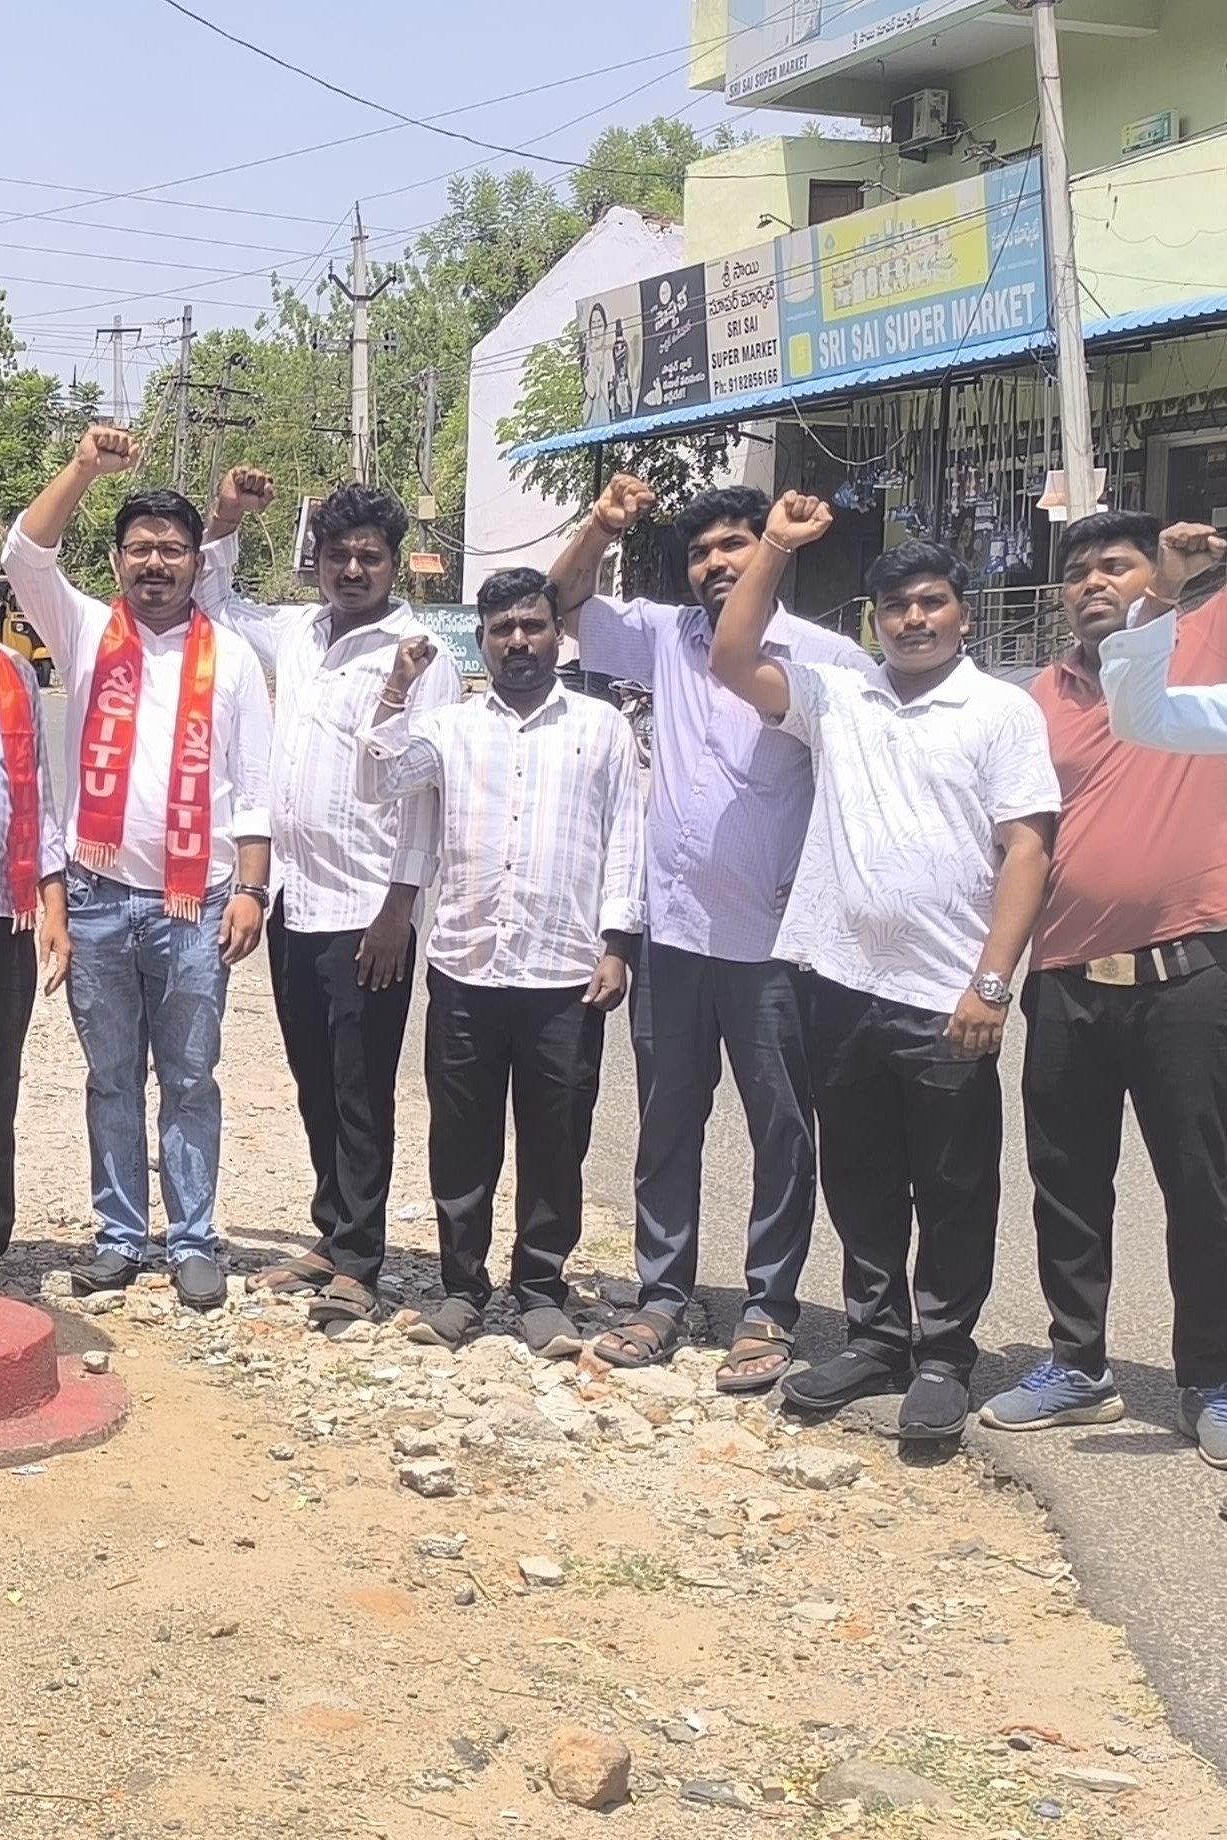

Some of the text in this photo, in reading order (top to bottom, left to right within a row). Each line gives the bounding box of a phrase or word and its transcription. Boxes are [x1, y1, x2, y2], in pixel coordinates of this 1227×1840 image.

[729, 54, 808, 98] SRI SAI SUPER MARKET
[728, 315, 758, 338] SRI SAI
[819, 282, 1036, 369] SRI SAI SUPER MARKET
[712, 348, 740, 369] SUPER
[742, 339, 777, 361] MARKET
